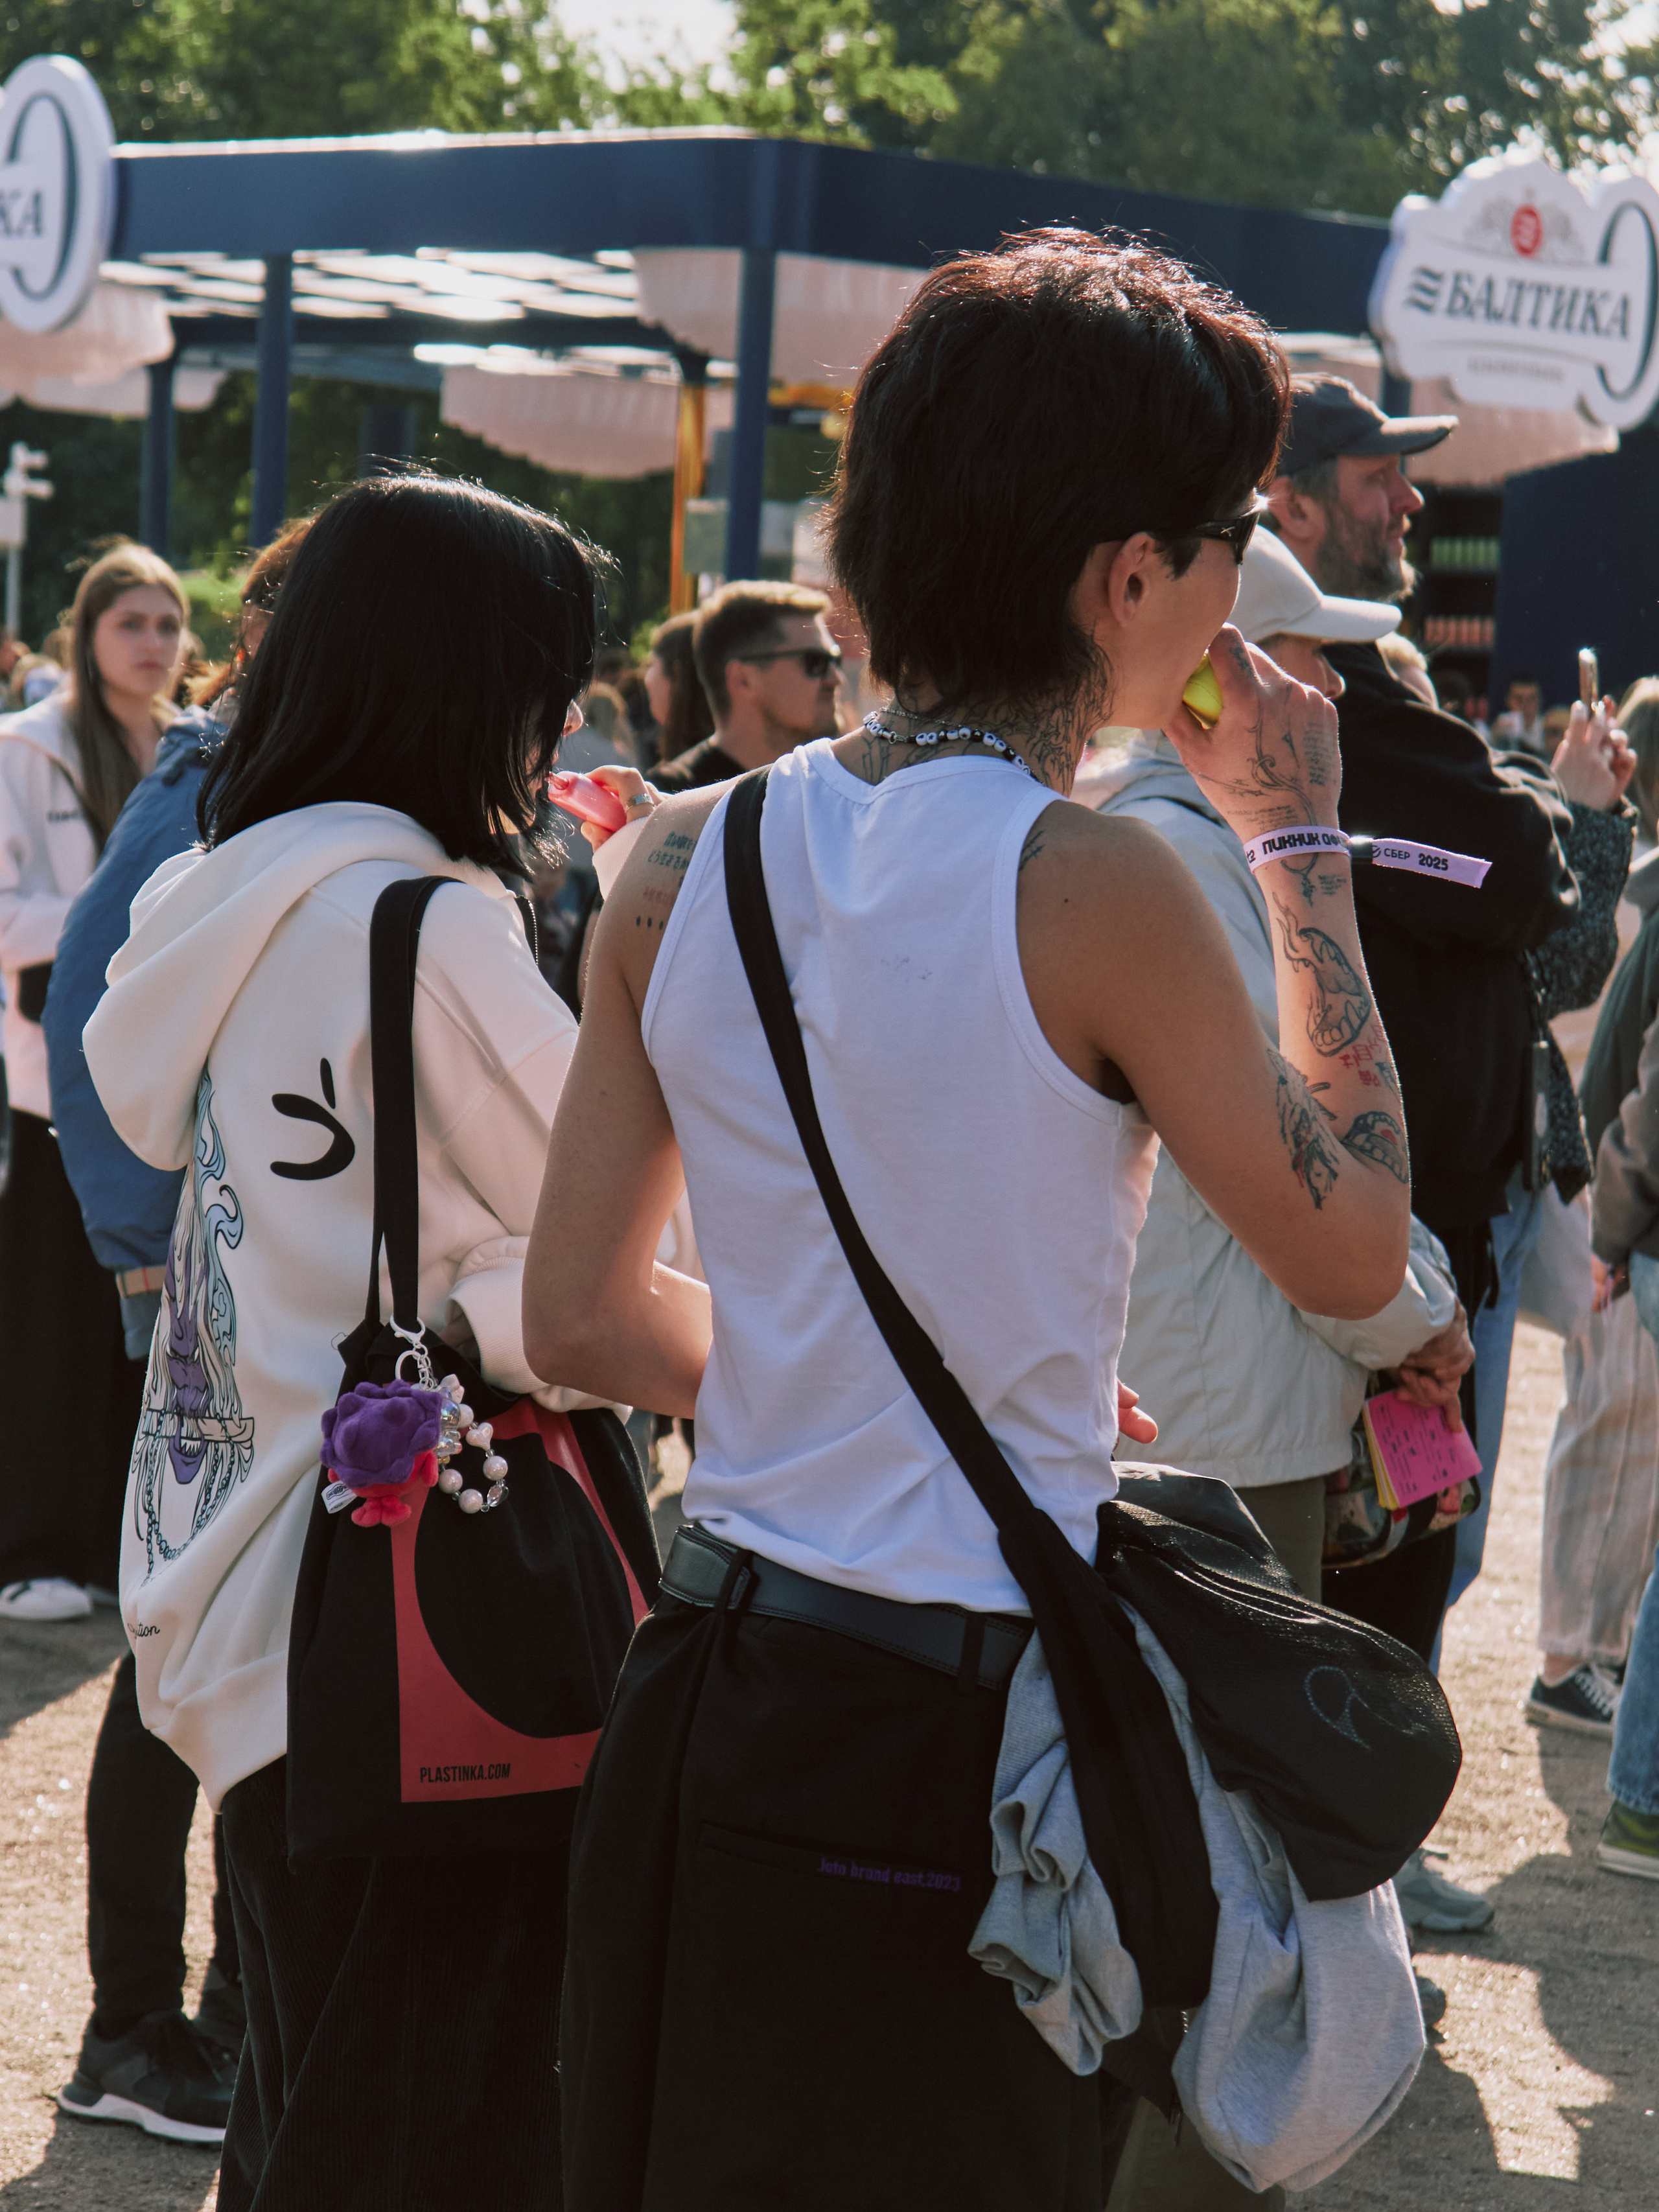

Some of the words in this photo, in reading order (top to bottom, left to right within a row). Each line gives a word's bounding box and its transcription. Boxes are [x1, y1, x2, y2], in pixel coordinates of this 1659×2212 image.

[1444, 269, 1631, 340] БАЛТИКА
[1262, 833, 1320, 856] ПИКНИК
[1384, 848, 1411, 860] СБЕР
[1418, 853, 1449, 871] 2025
[419, 1763, 511, 1783] PLASTINKA.COM
